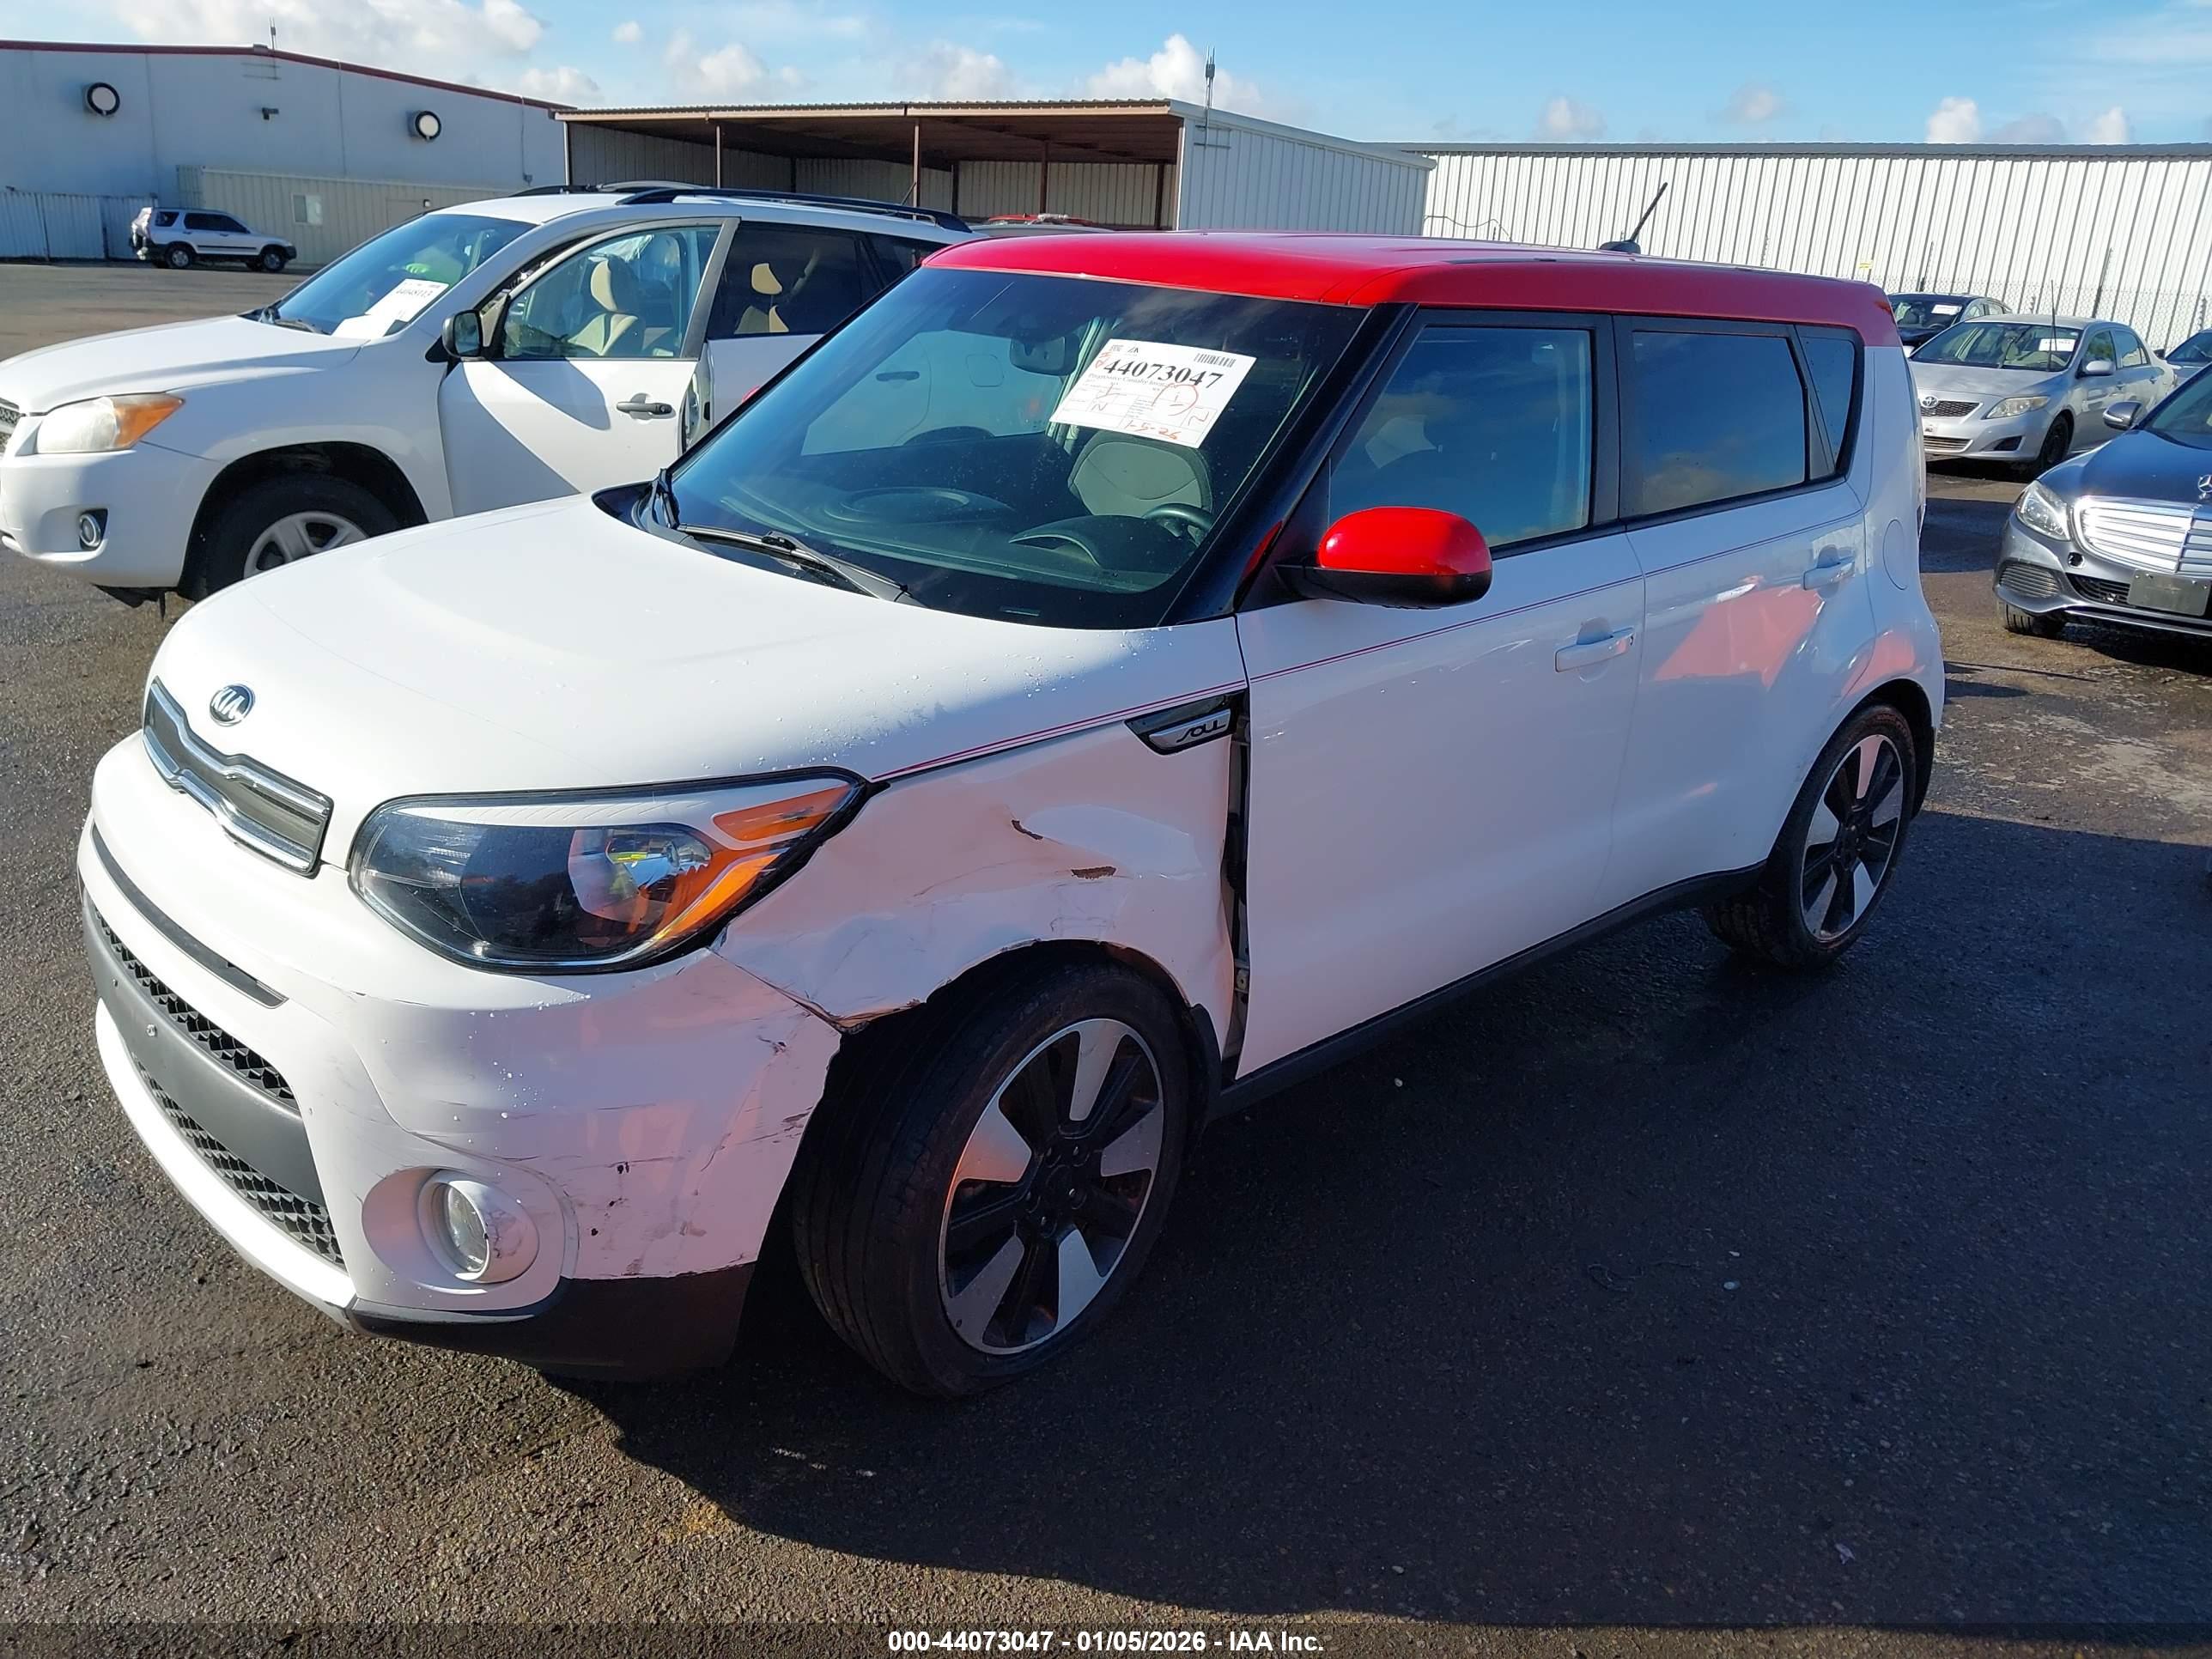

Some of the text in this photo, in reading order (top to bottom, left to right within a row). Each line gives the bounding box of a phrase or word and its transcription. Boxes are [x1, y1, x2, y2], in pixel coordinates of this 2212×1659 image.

[1104, 359, 1223, 389] 44073047
[210, 687, 246, 720] KIA
[1176, 719, 1226, 744] SOUL
